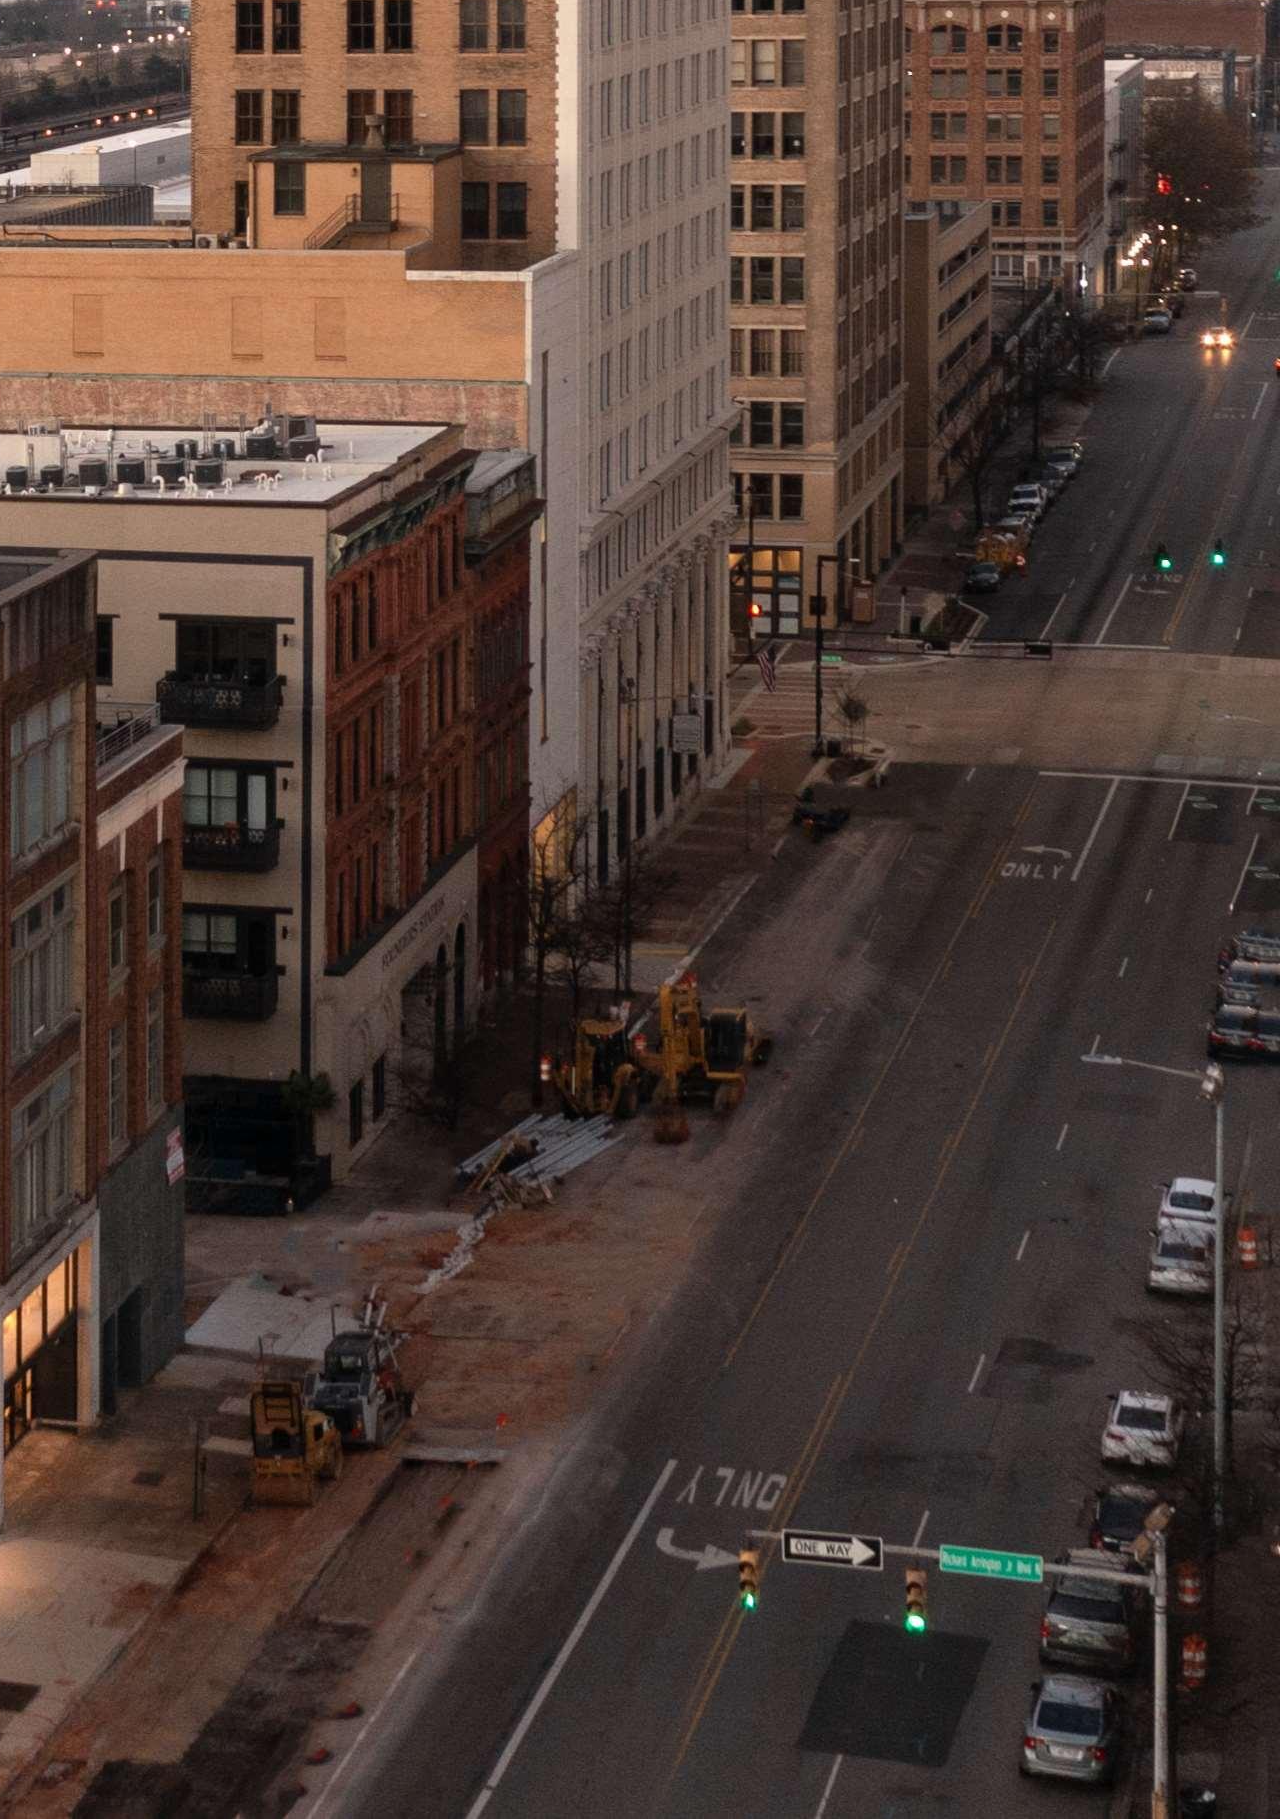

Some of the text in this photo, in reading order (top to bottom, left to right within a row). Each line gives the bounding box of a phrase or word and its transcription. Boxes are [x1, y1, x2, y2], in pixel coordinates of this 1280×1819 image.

[1001, 862, 1065, 880] ONLY
[676, 1465, 788, 1511] ONLY
[794, 1539, 851, 1555] ONE WAY
